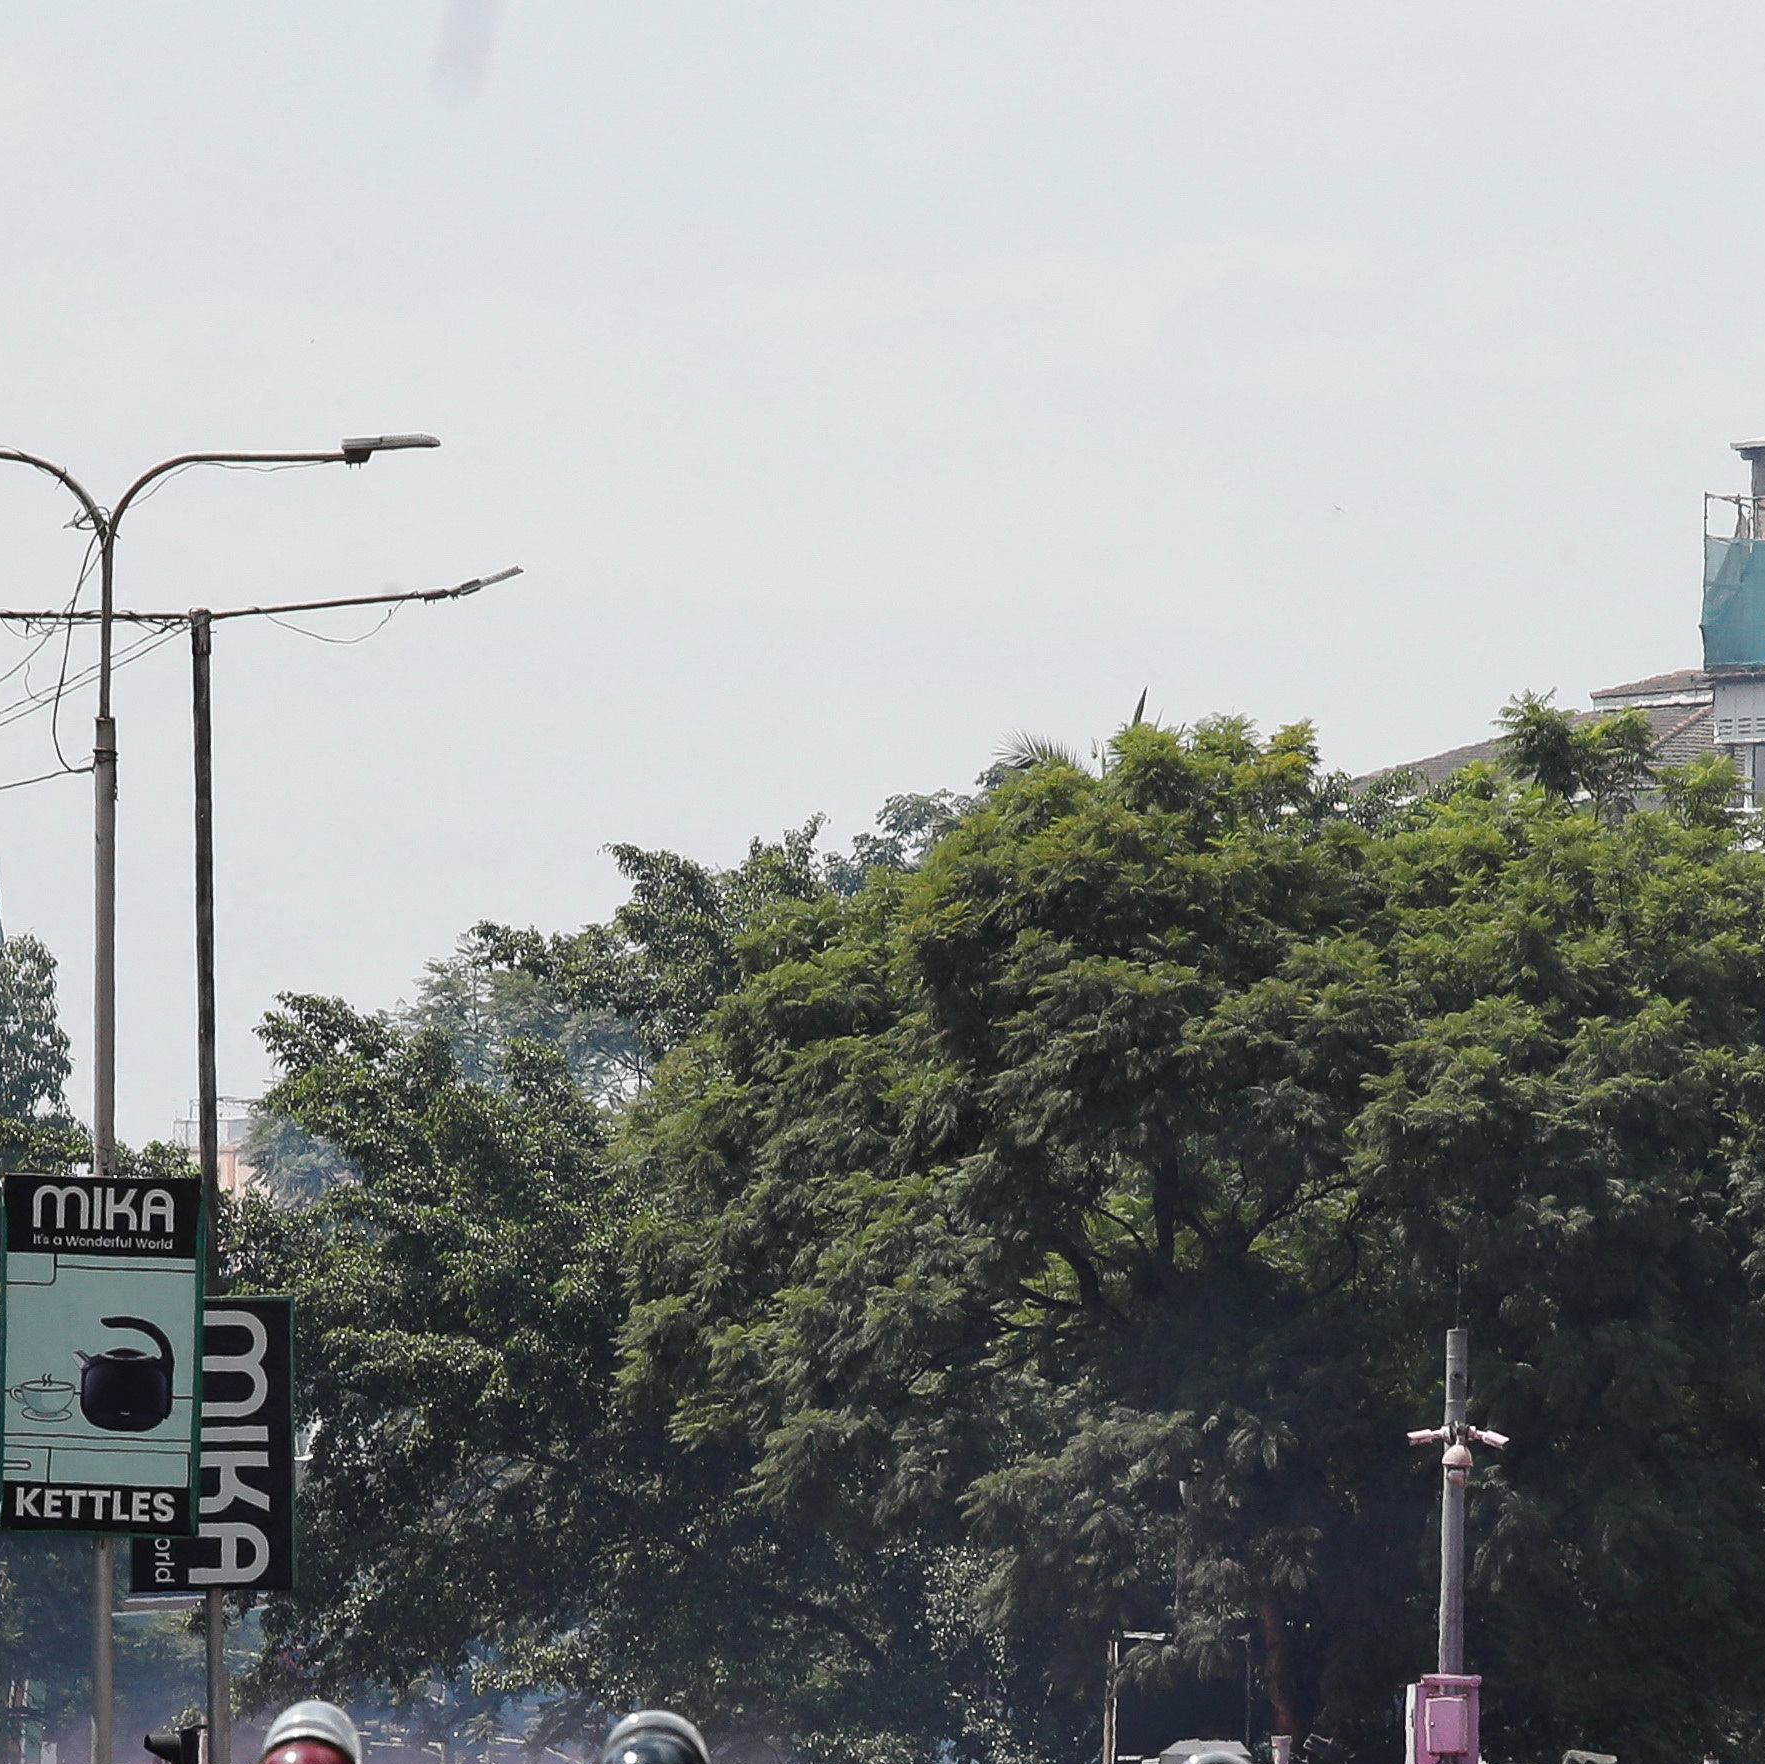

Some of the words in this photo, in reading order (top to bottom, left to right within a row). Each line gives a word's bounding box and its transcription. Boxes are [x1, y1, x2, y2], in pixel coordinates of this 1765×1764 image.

[32, 1184, 175, 1233] MIKA
[33, 1233, 49, 1245] It's
[53, 1236, 62, 1246] a
[65, 1234, 132, 1249] Wonderful
[135, 1237, 174, 1250] World
[188, 1310, 270, 1585] MIKA
[15, 1486, 175, 1524] KETTLES
